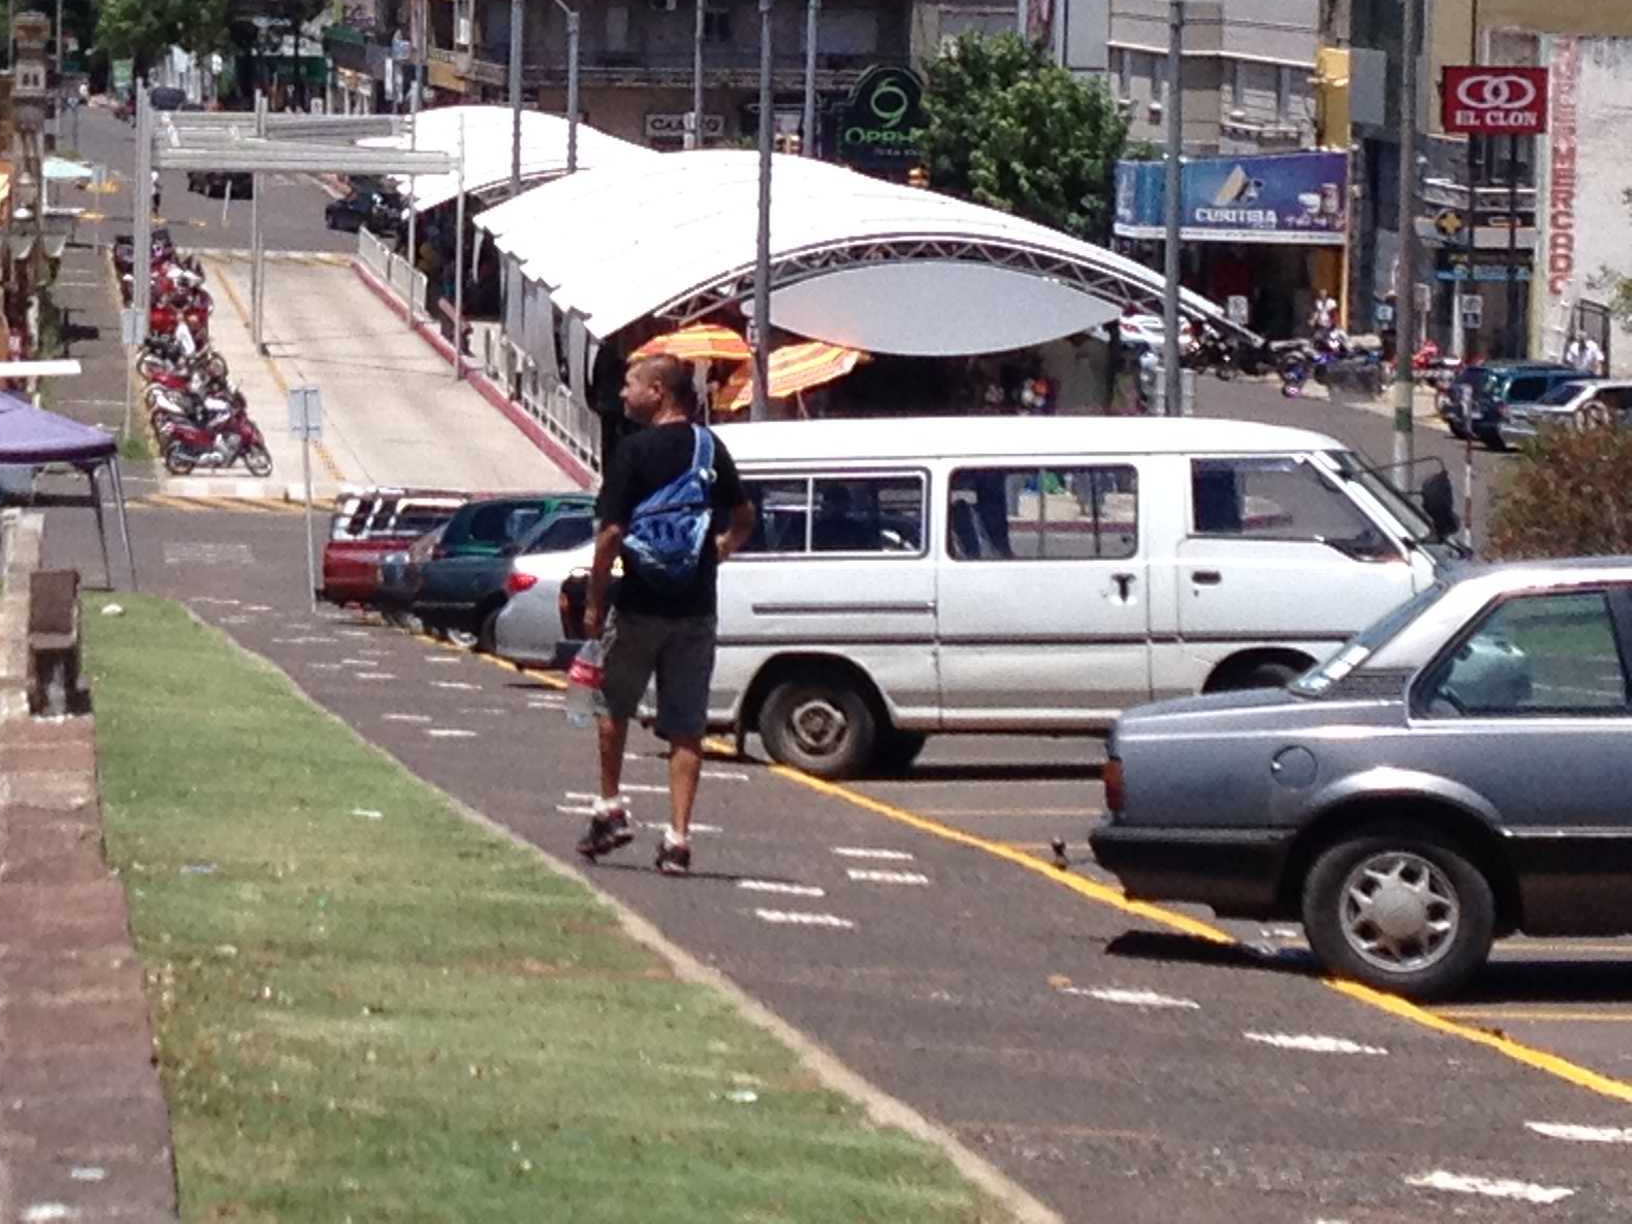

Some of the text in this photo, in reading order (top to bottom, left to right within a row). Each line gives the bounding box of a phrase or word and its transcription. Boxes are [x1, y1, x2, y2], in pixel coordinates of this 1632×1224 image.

[1455, 110, 1538, 127] EL CLON
[1195, 207, 1278, 223] CURITIBA
